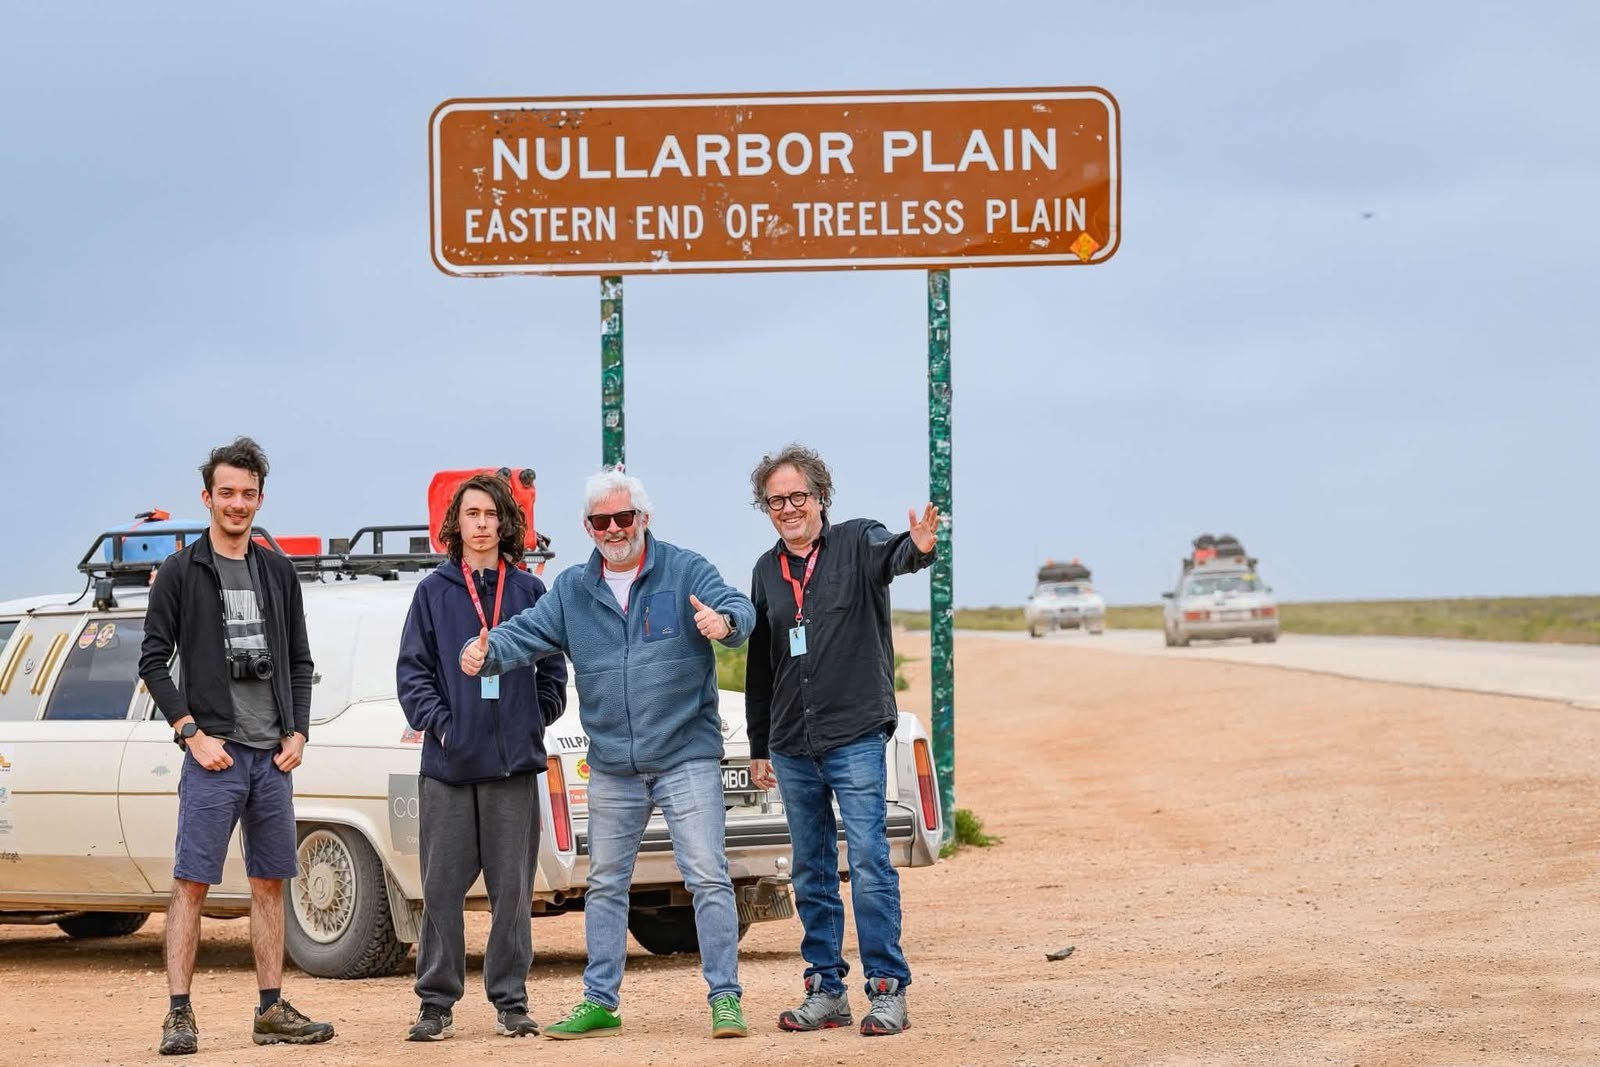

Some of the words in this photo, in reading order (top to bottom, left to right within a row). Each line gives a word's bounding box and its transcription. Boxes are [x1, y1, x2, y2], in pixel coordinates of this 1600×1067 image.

[492, 130, 855, 181] NULLARBOR
[882, 127, 1057, 174] PLAIN
[465, 206, 617, 244] EASTERN
[635, 204, 704, 242] END
[725, 203, 770, 240] OF
[793, 199, 965, 238] TREELESS
[986, 197, 1087, 234] PLAIN
